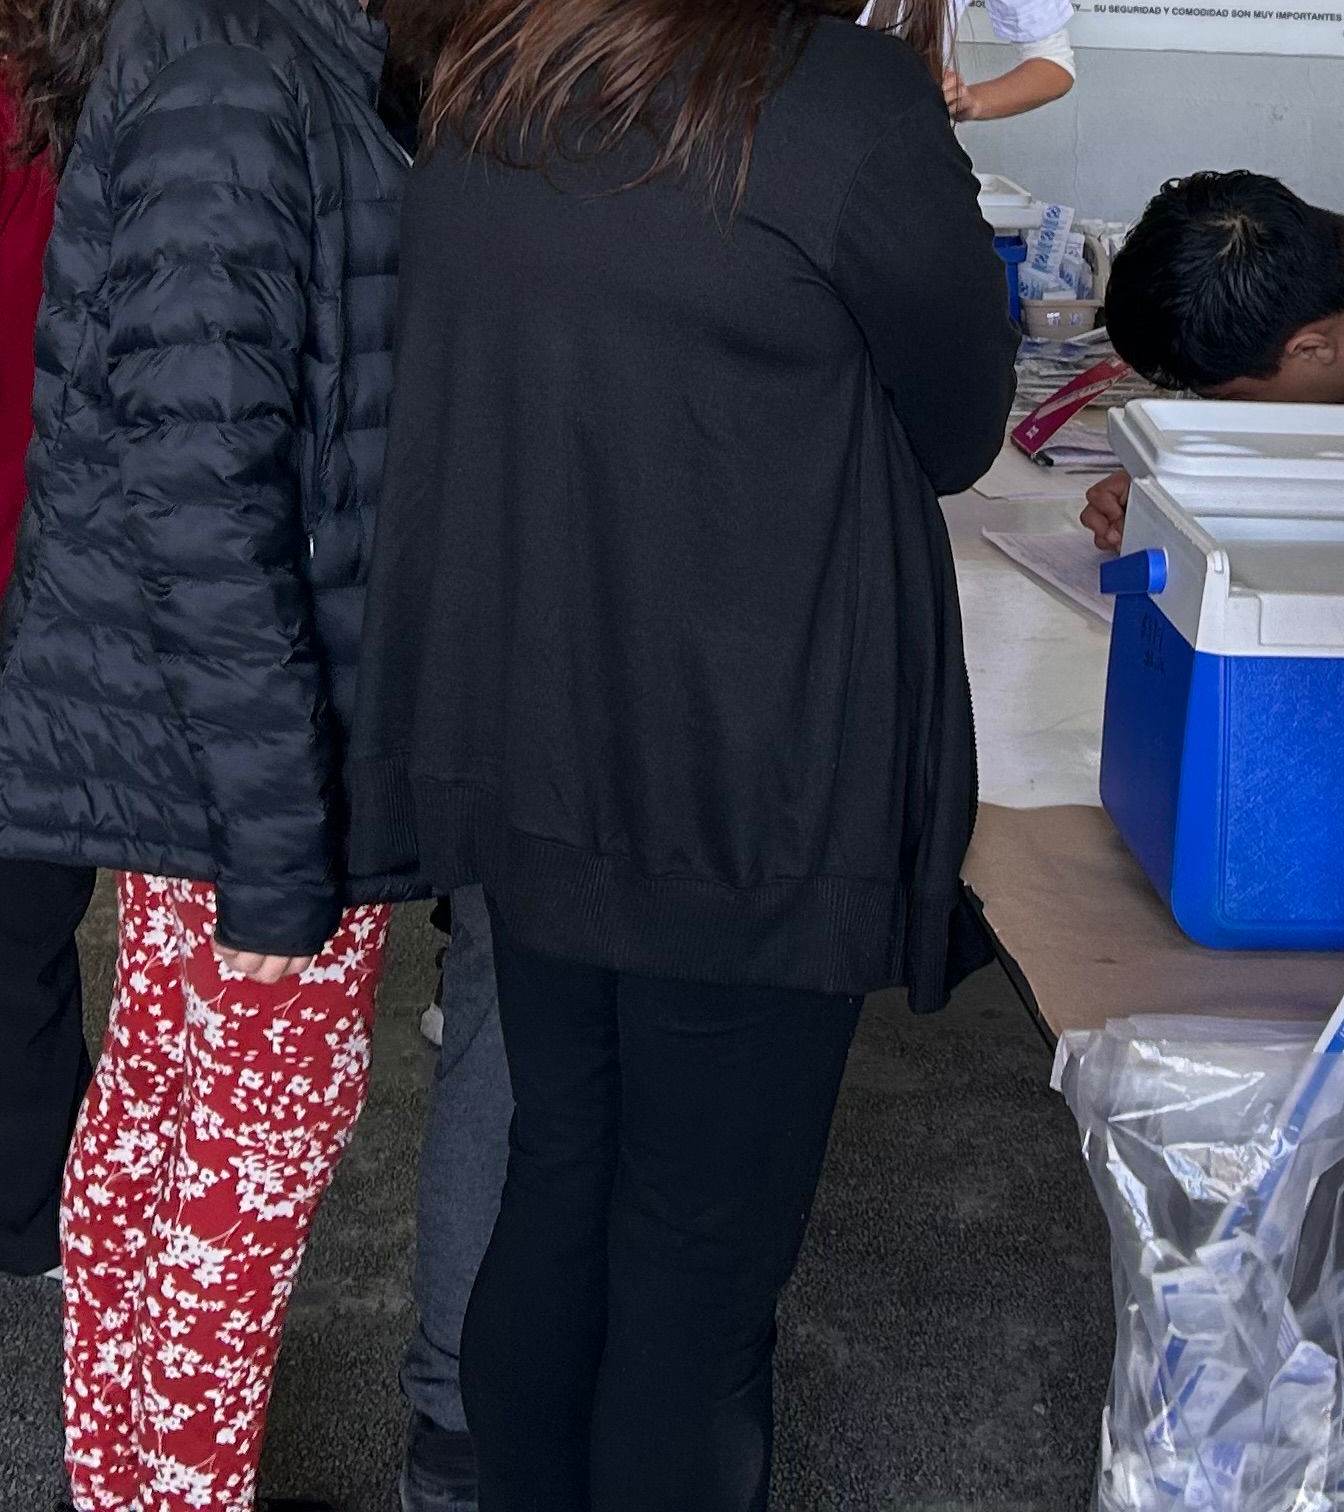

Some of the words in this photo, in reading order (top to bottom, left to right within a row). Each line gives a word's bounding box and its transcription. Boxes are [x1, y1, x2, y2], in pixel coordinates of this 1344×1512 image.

[1093, 3, 1106, 13] SU
[1108, 4, 1161, 15] SEGURIDAD
[1163, 6, 1169, 15] Y
[1171, 6, 1229, 18] COMODIDAD
[1230, 8, 1251, 18] SON
[1253, 9, 1274, 19] MUY
[1275, 10, 1342, 22] IMPORTANTES
